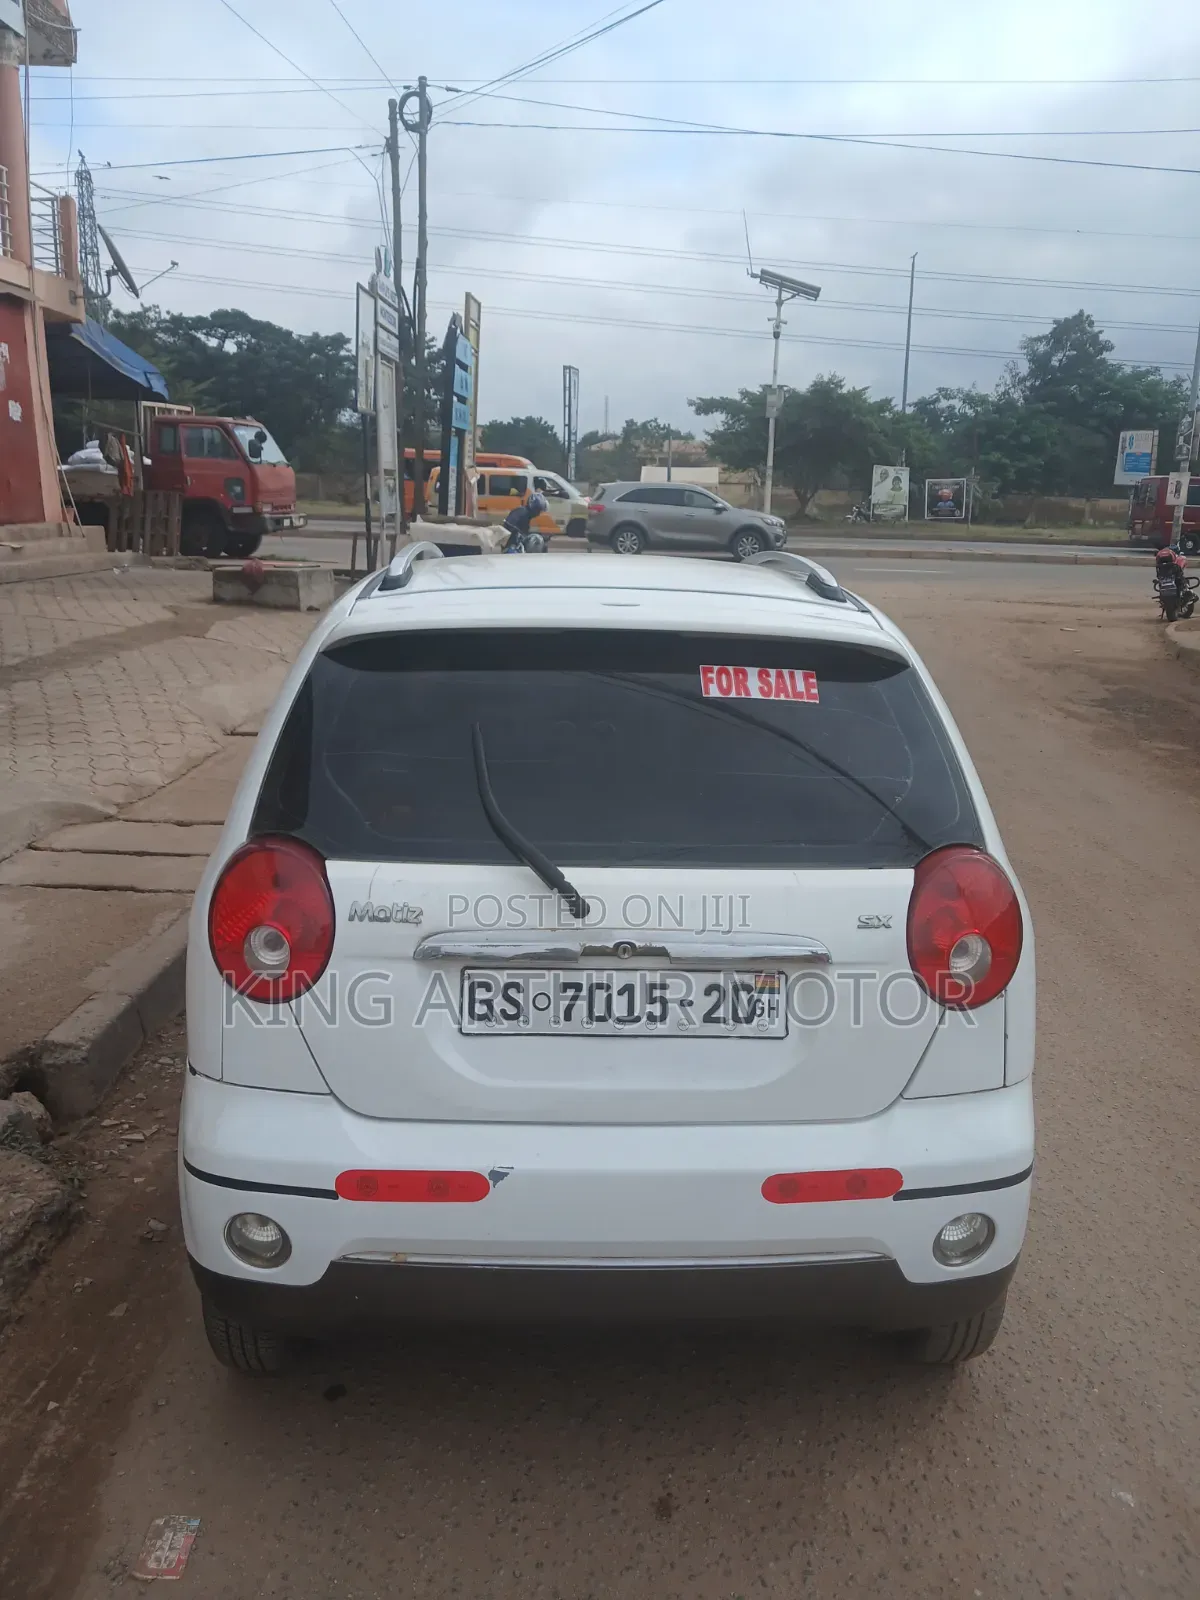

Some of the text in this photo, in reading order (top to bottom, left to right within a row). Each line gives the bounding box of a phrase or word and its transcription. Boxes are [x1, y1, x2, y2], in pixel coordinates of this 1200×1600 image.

[701, 666, 819, 701] FOR SALE
[348, 900, 424, 924] Matiz
[857, 914, 893, 929] SX
[754, 999, 780, 1019] GH
